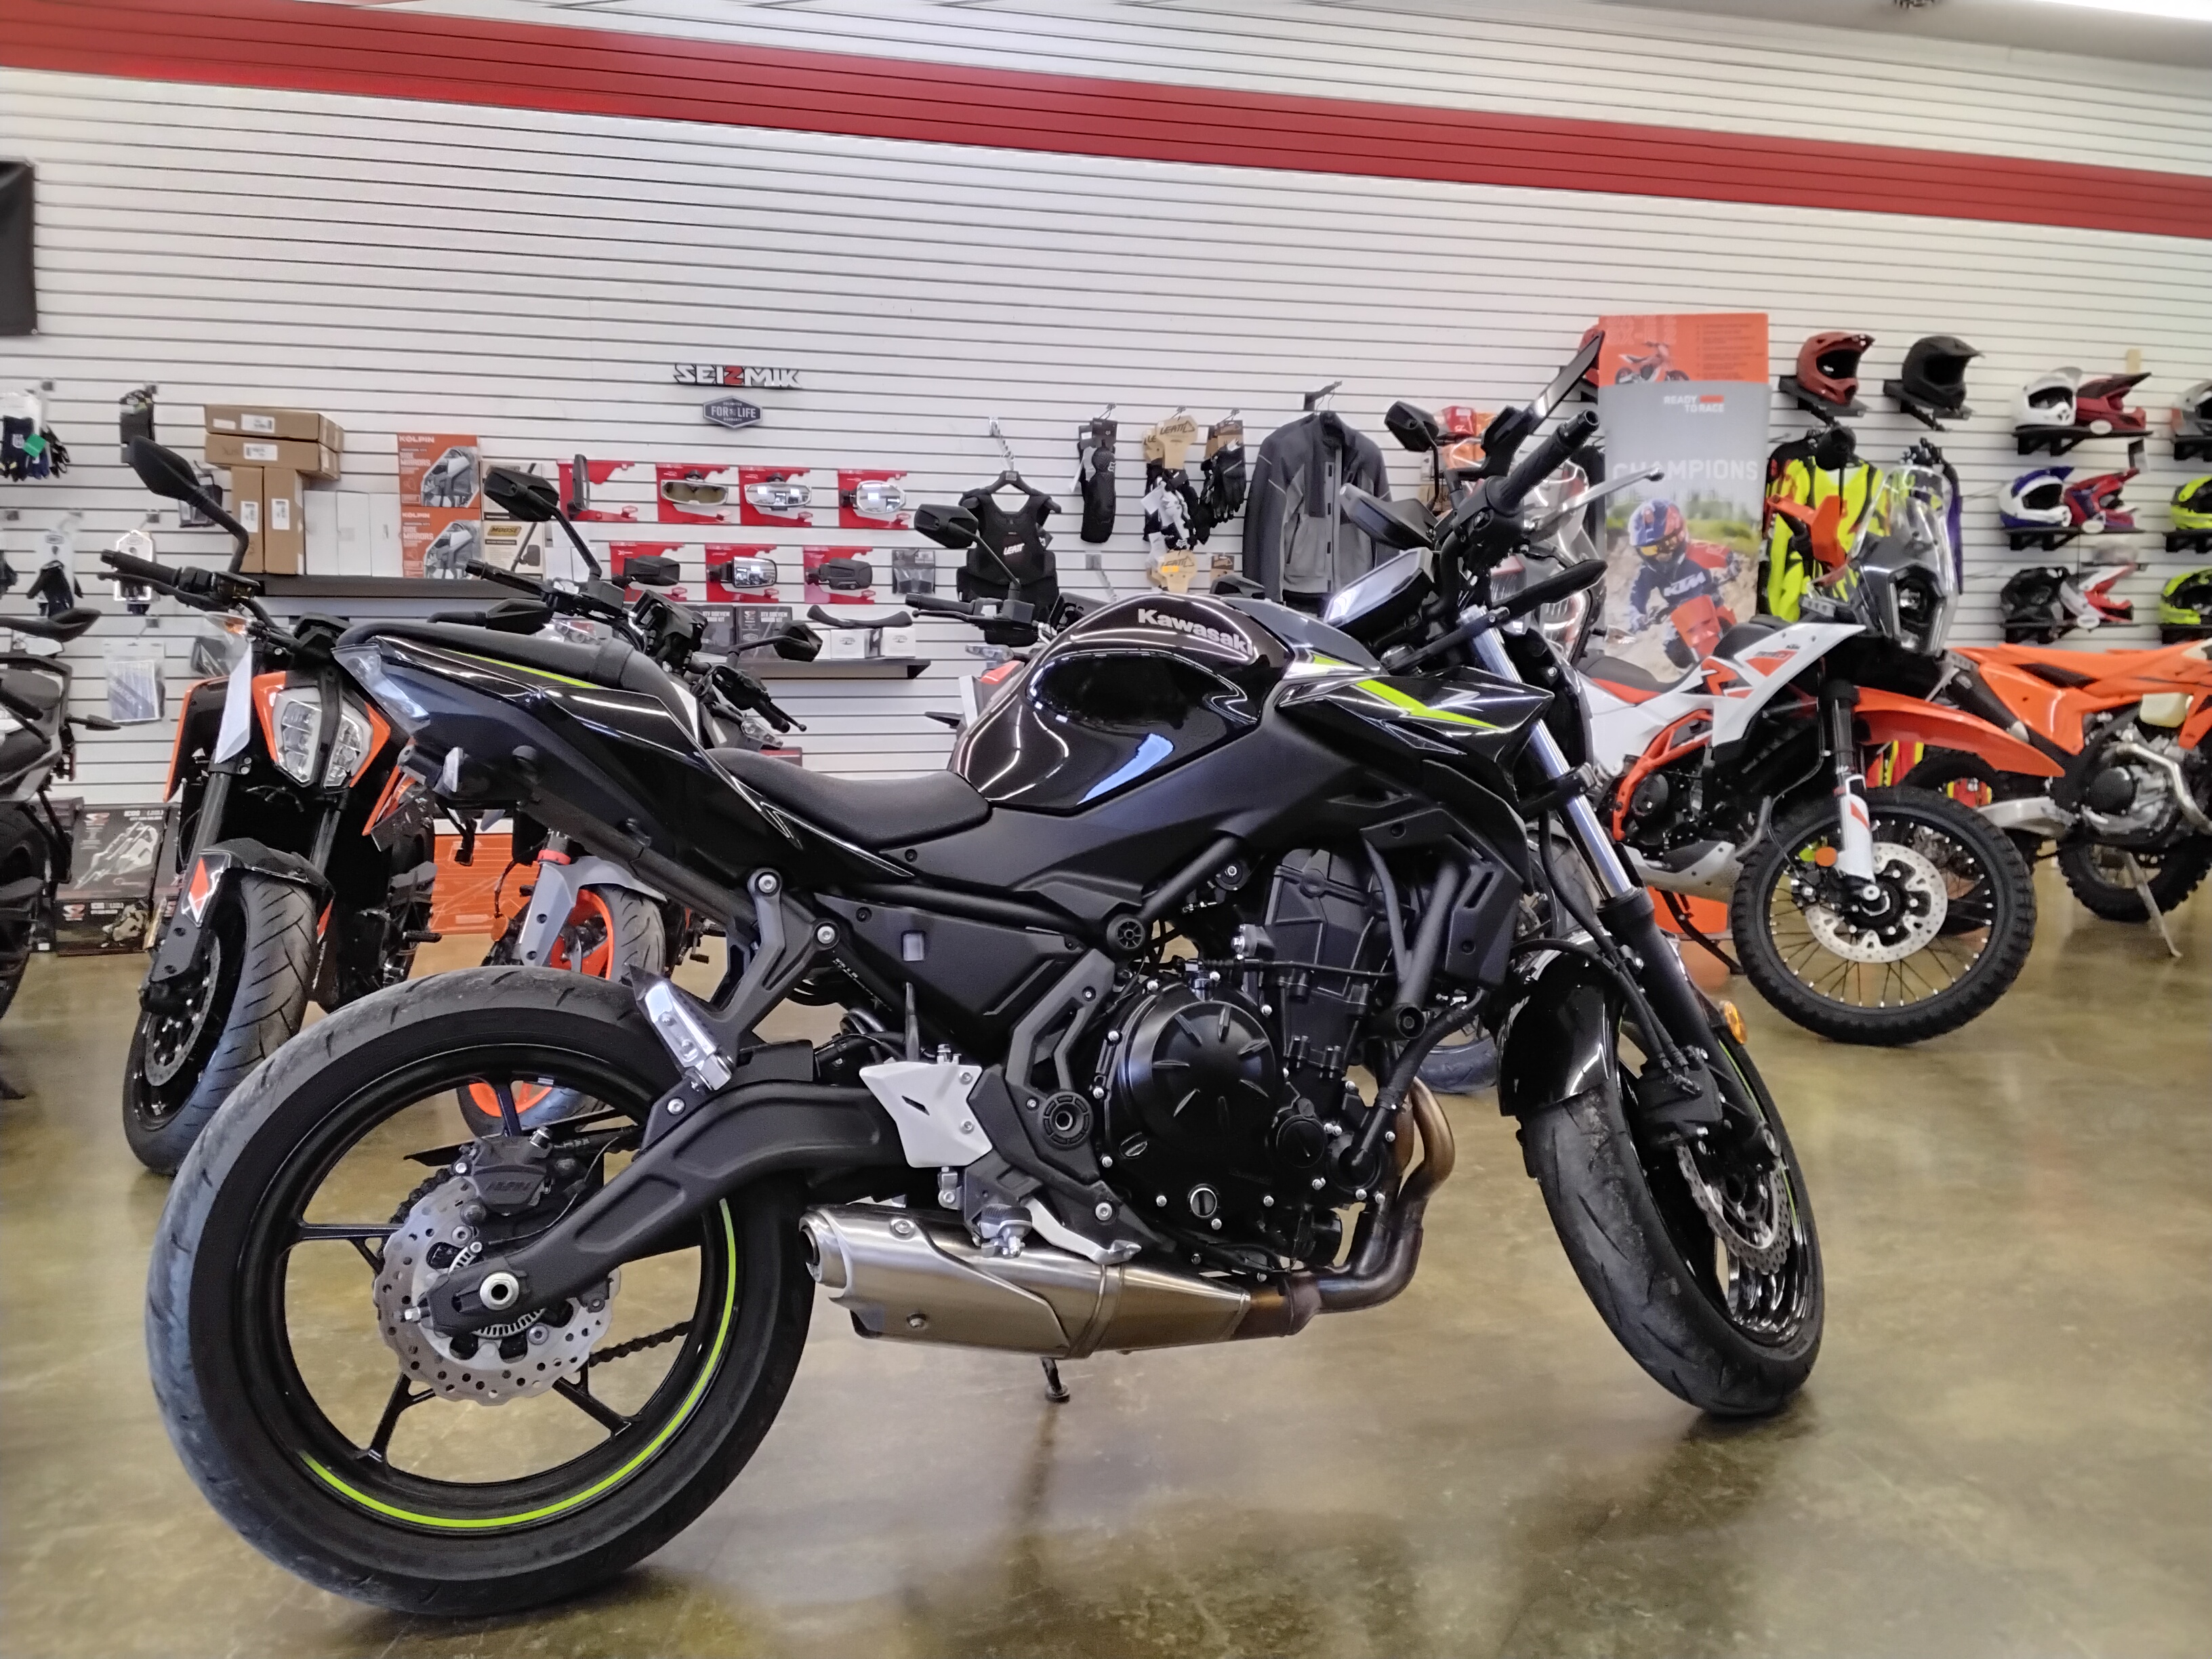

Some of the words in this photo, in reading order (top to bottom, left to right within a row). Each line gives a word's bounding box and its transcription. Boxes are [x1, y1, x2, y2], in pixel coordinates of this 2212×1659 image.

[673, 365, 803, 388] SEIZMIK
[1664, 395, 1697, 405] READY
[711, 406, 729, 417] FOR
[737, 407, 756, 418] LIFE
[1685, 404, 1697, 413] TO
[1698, 403, 1724, 413] RACE
[398, 435, 434, 443] KOLPIN
[401, 459, 431, 467] MIRRORS
[403, 532, 434, 540] MIRRORS
[1003, 543, 1025, 555] LEATT
[1664, 571, 1706, 597] KTM
[1138, 609, 1253, 656] Kawasaki
